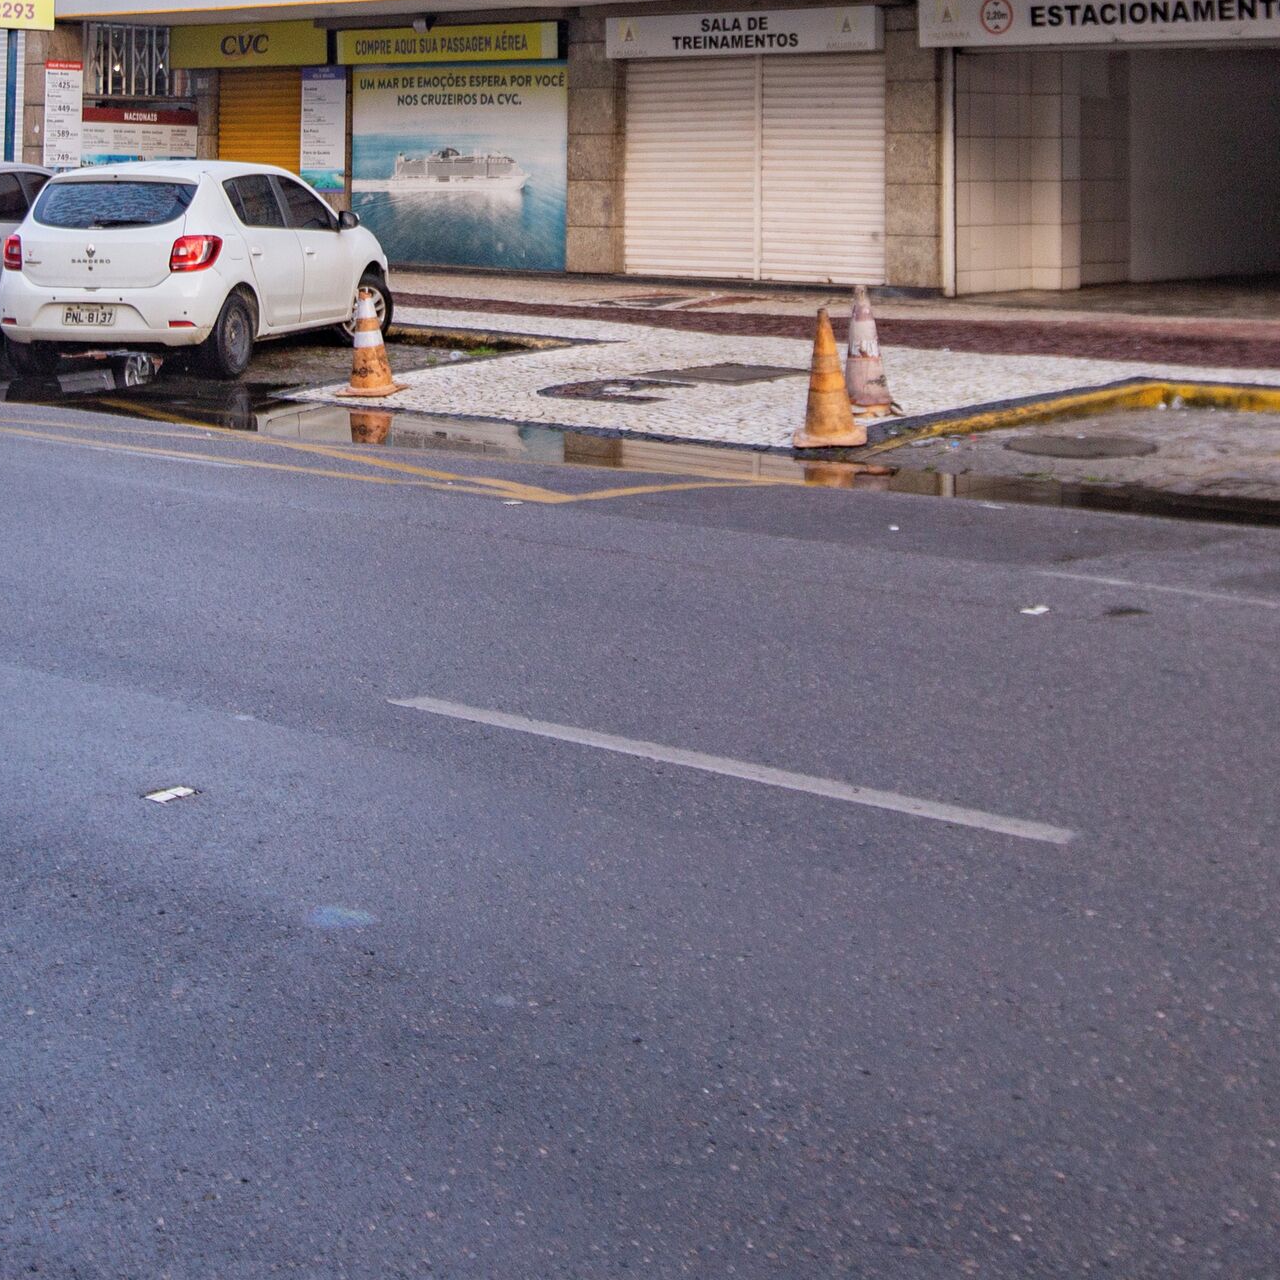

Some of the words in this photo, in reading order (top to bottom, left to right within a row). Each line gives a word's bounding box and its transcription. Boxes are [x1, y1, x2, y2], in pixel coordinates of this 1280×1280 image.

[701, 18, 741, 32] SALA
[747, 17, 768, 31] DE
[221, 34, 269, 55] CVC
[355, 40, 392, 55] COMPRE
[395, 39, 417, 54] AQUI
[420, 37, 438, 53] SUA
[441, 35, 492, 53] PASSAGEM
[495, 30, 528, 51] AÉREA
[672, 33, 799, 50] TREINAMENTOS
[360, 79, 375, 90] UM
[378, 77, 400, 89] MAR
[402, 76, 415, 88] DE
[420, 73, 467, 91] EMOÇÕES
[469, 75, 508, 88] ESPERA
[511, 74, 532, 87] POR
[535, 71, 565, 87] VOCÊ
[397, 94, 419, 106] NOS
[421, 93, 478, 106] CRUZEIROS
[480, 93, 495, 105] DA
[497, 93, 522, 105] CVC.
[123, 111, 158, 122] NACIONAIS
